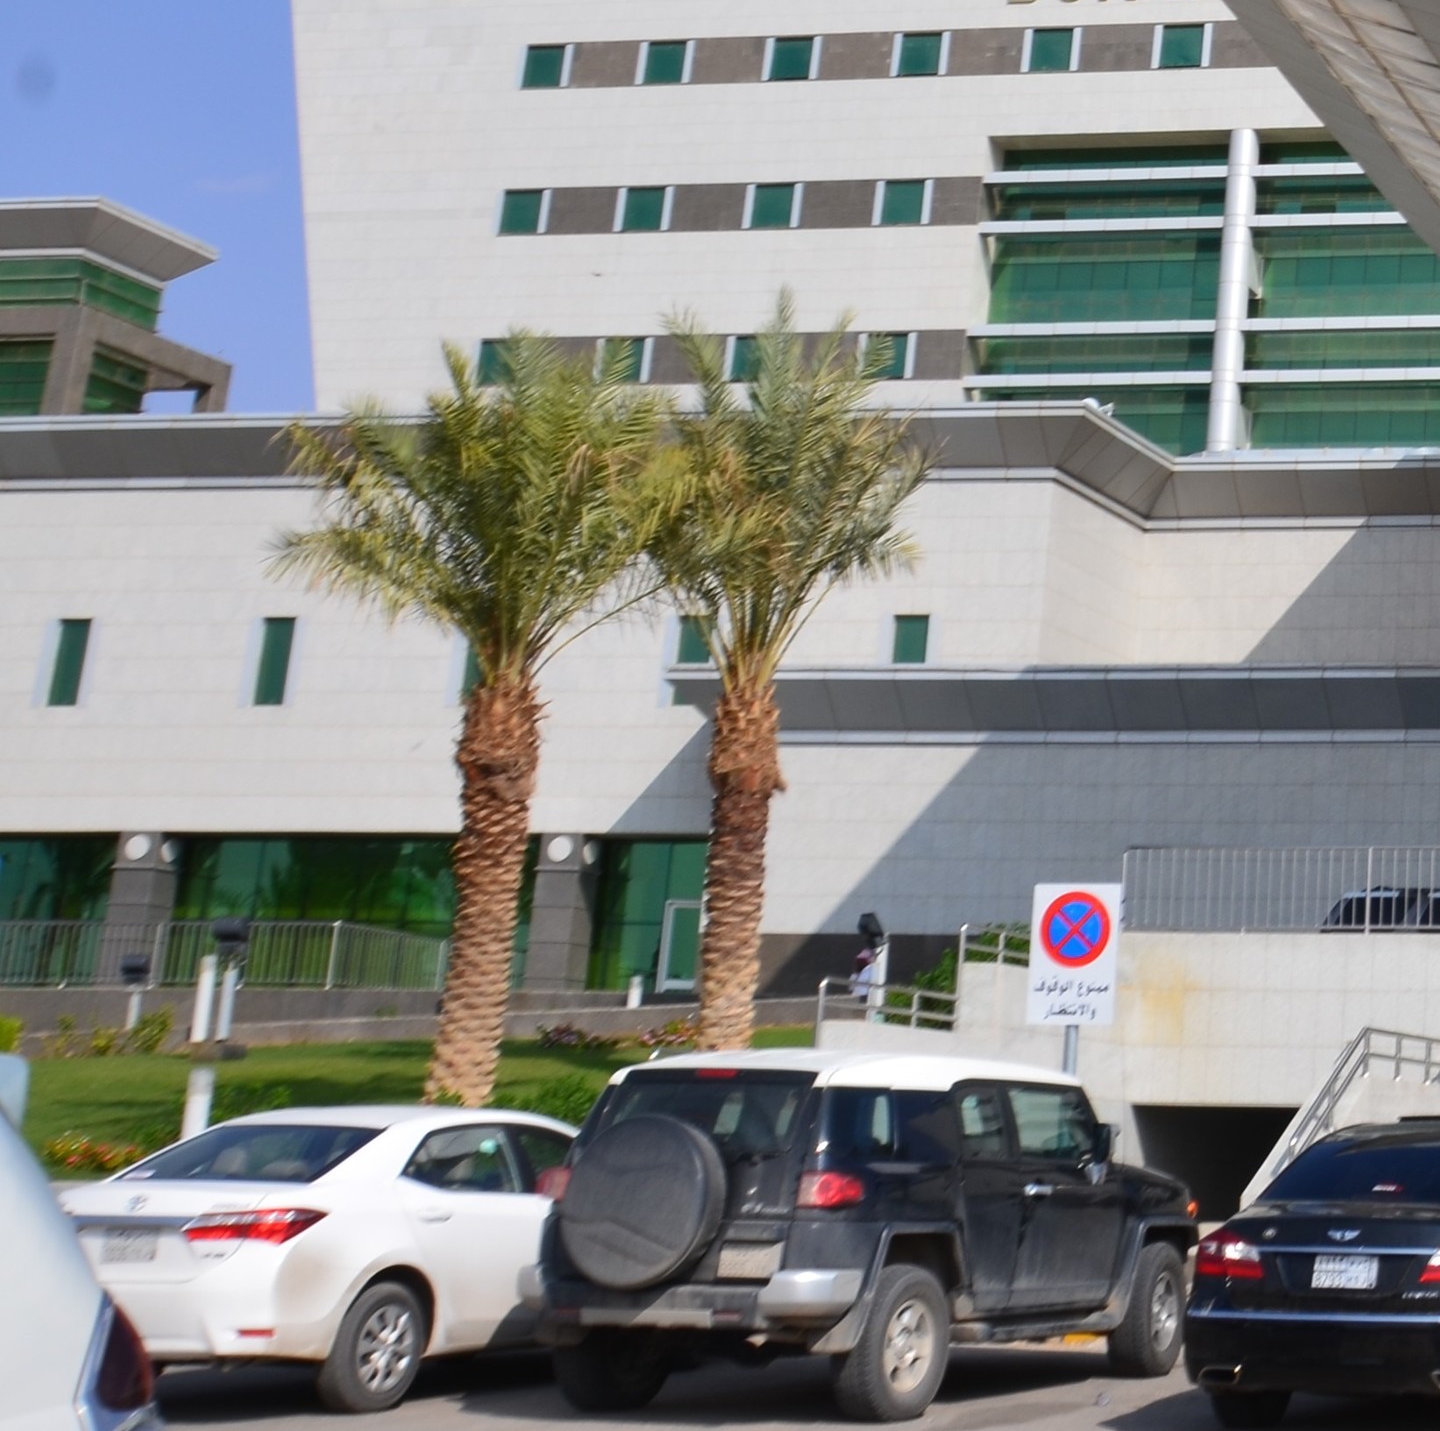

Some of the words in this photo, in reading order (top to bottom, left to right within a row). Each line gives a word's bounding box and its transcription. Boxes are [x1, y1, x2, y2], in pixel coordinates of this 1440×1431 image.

[1034, 975, 1074, 997] الوقوف
[1077, 981, 1110, 998] ممنوع
[1044, 1003, 1097, 1020] والانتظار
